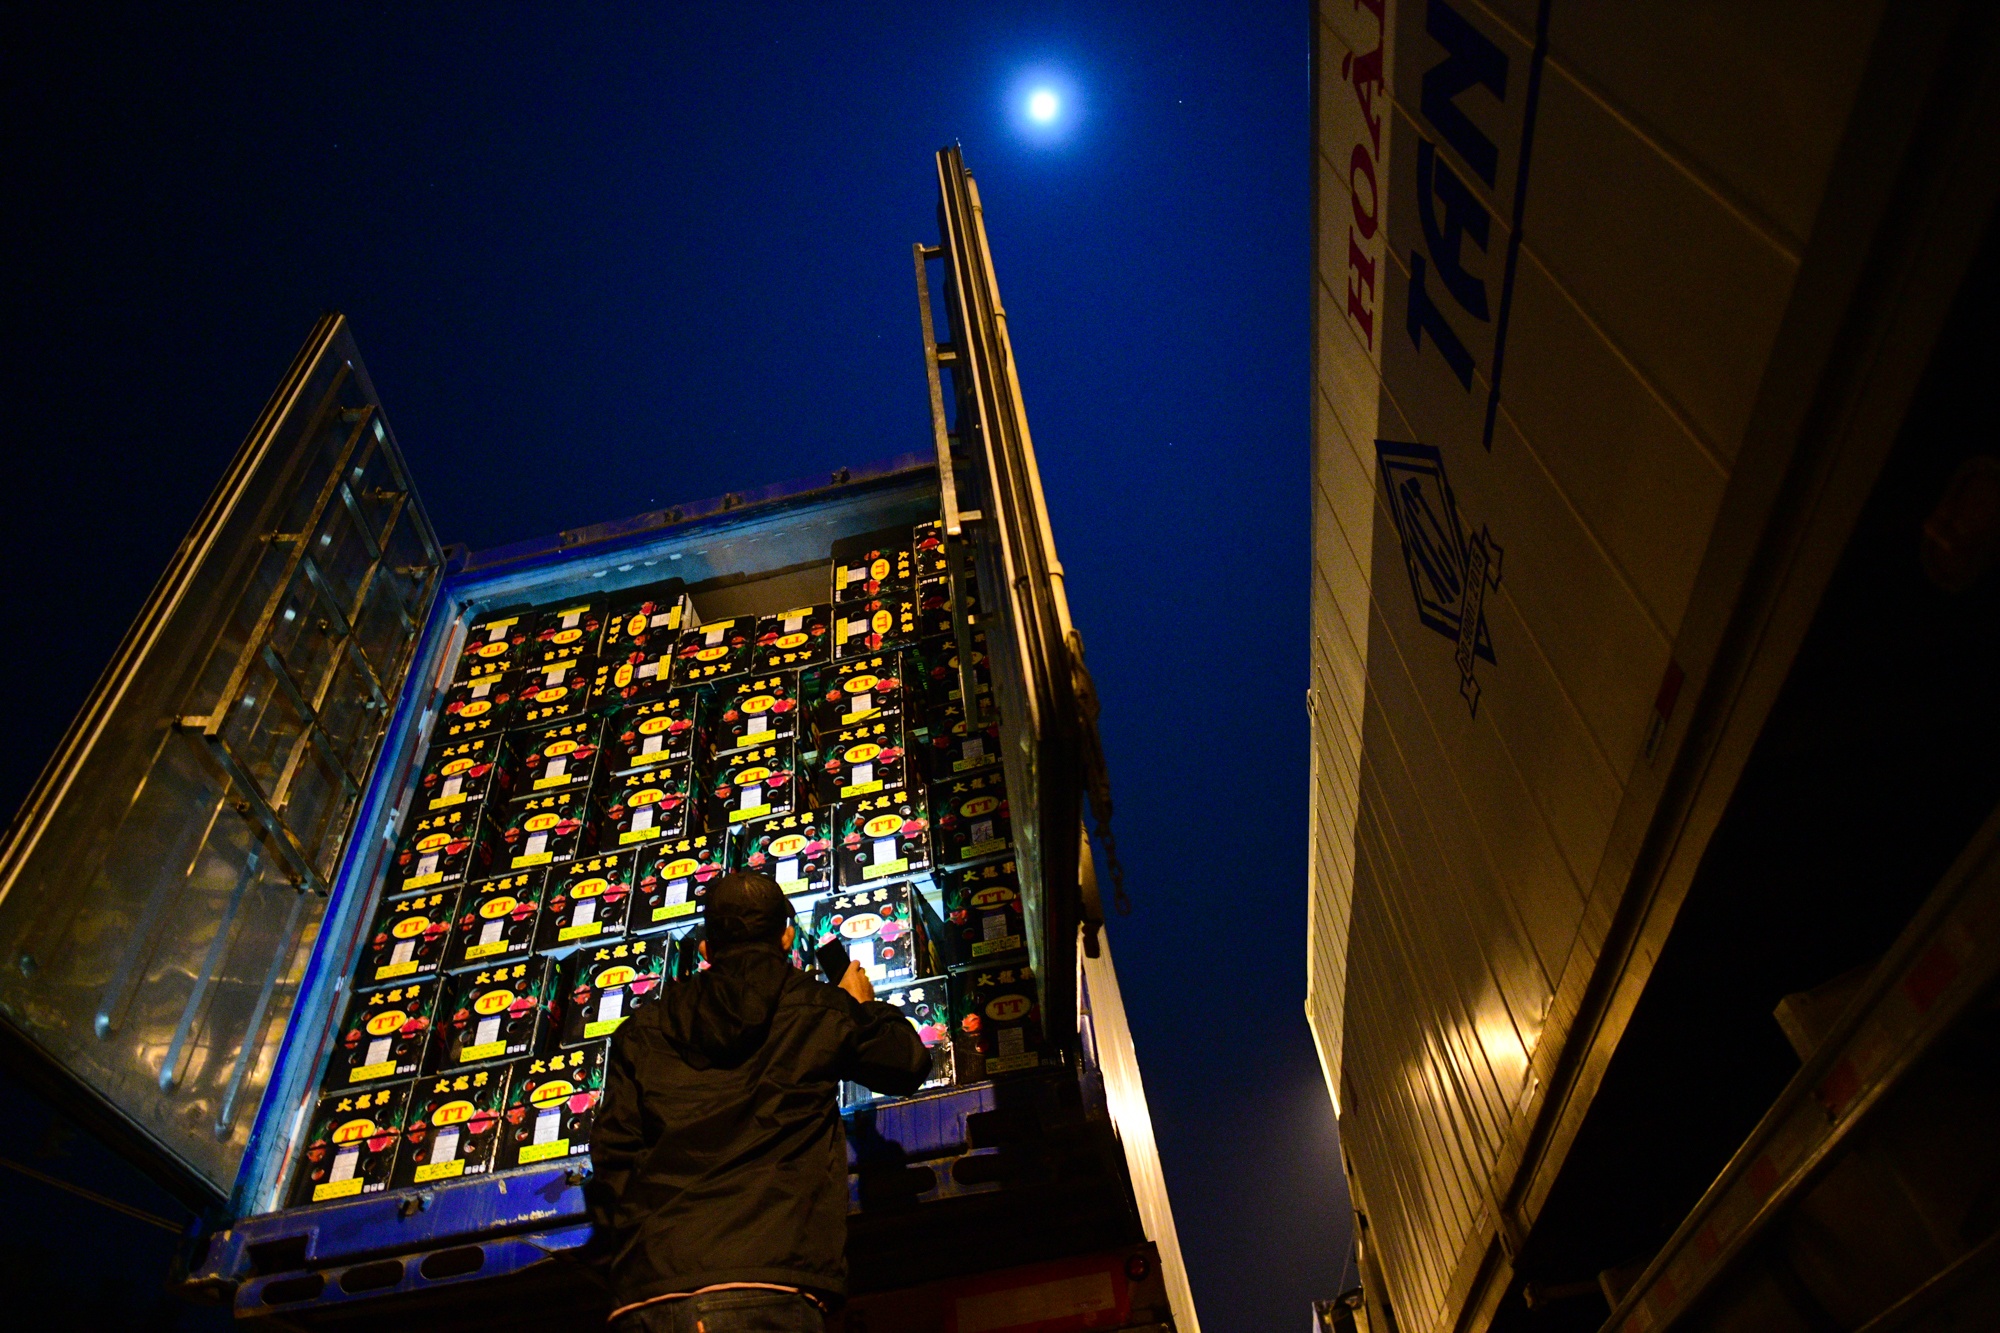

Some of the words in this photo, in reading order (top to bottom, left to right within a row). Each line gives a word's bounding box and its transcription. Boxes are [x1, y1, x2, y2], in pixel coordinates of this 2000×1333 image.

[1406, 0, 1509, 394] TAN
[558, 632, 576, 641] TT
[782, 636, 801, 646] TT
[484, 645, 502, 654] TT
[705, 649, 722, 657] TT
[850, 678, 872, 688] TT
[542, 690, 561, 699] TT
[465, 704, 484, 714] TT
[748, 698, 769, 709] TT
[646, 720, 666, 730] TT
[553, 744, 572, 753] TT
[851, 747, 874, 758] TT
[449, 762, 468, 771] TT
[741, 770, 763, 780] TT
[635, 792, 657, 804] TT
[967, 800, 991, 815] TT
[532, 817, 554, 828] TT
[871, 818, 895, 832] TT
[424, 837, 444, 846] TT
[776, 839, 800, 852] TT
[669, 862, 692, 875] TT
[578, 882, 601, 895] TT
[978, 890, 1006, 905] TT
[488, 901, 510, 913] TT
[401, 921, 423, 933] TT
[848, 917, 875, 933] TT
[604, 971, 628, 984] TT
[483, 994, 507, 1009] TT
[993, 999, 1022, 1015] TT
[375, 1015, 400, 1029] TT
[539, 1086, 566, 1097] TT
[441, 1106, 467, 1122] TT
[342, 1124, 368, 1140] TT
